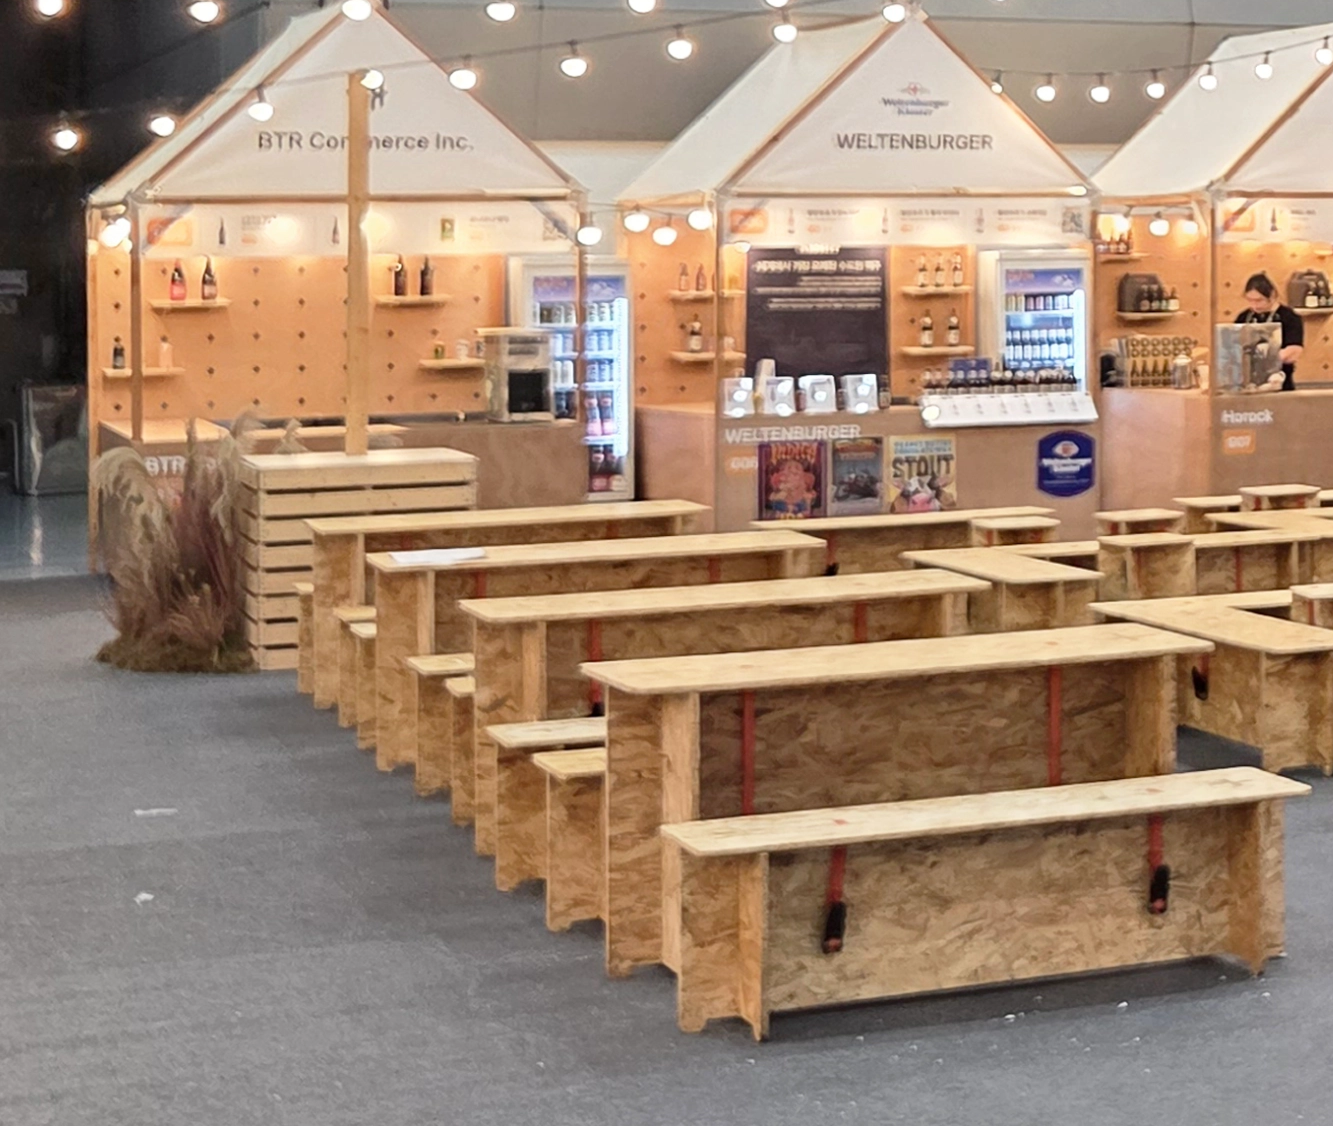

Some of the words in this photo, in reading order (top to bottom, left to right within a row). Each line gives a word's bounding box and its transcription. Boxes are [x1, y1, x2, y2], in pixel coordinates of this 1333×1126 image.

[258, 131, 303, 150] BTR
[434, 133, 475, 151] Inc.
[836, 132, 994, 151] WELTENBURGER
[1221, 409, 1274, 423] Horock
[725, 424, 861, 443] WELTENBURGER
[892, 454, 955, 478] STOUT
